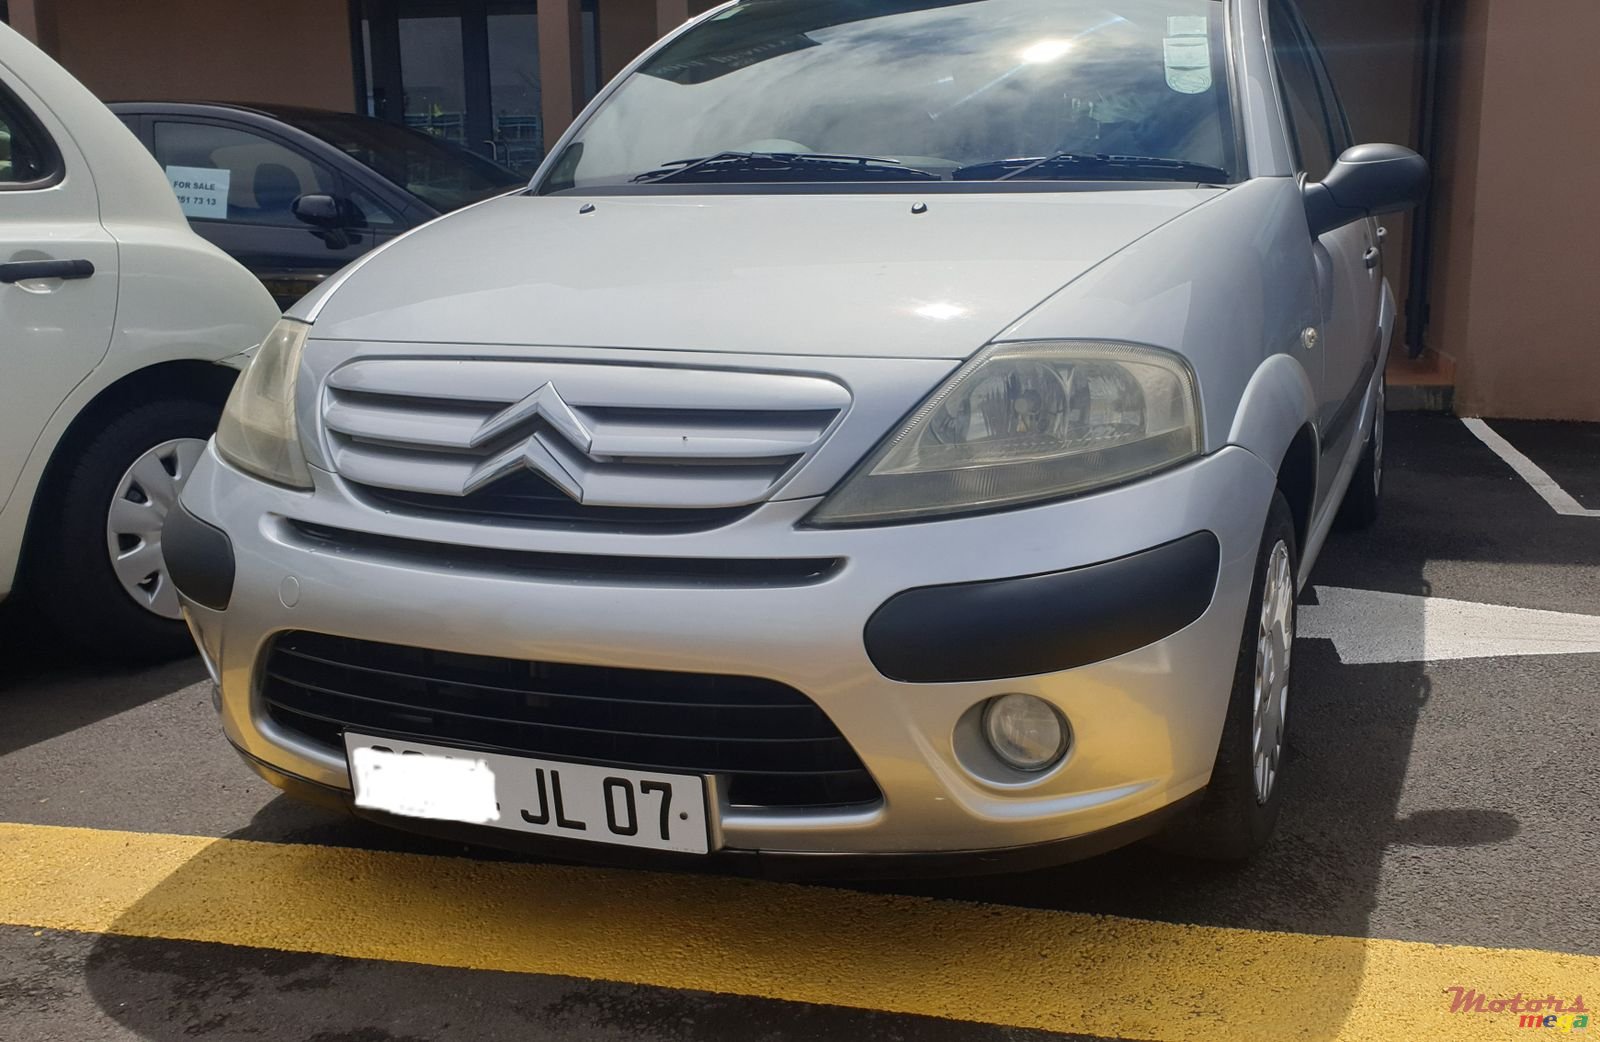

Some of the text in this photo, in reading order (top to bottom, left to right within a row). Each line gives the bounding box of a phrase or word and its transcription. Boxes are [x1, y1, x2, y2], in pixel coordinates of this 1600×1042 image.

[173, 181, 215, 190] FOR SALE
[206, 198, 216, 206] 13
[520, 768, 586, 831] JL
[603, 777, 673, 841] 07
